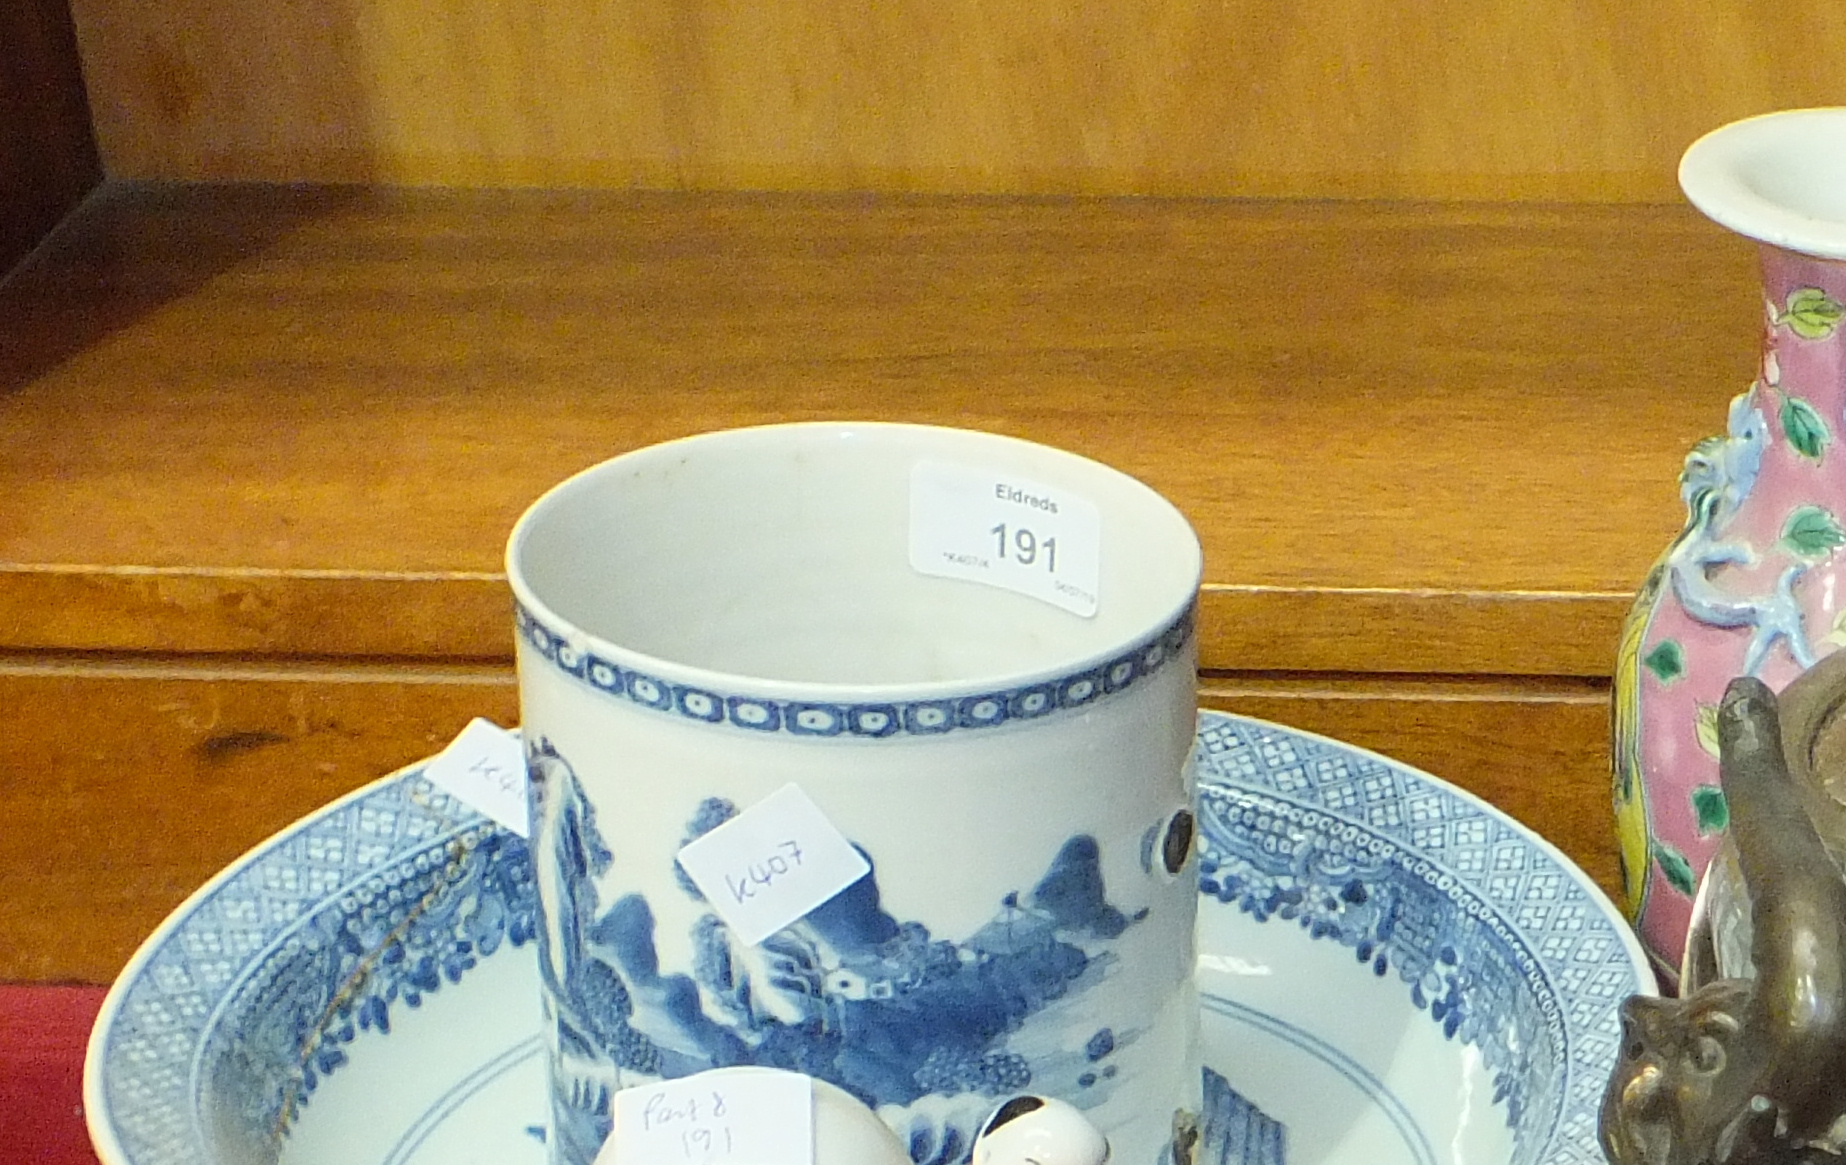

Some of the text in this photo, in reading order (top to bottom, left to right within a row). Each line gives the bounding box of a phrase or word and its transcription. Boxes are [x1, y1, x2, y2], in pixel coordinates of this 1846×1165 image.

[994, 483, 1059, 514] Eldreds
[990, 522, 1057, 573] 191
[681, 1126, 733, 1159] 191
